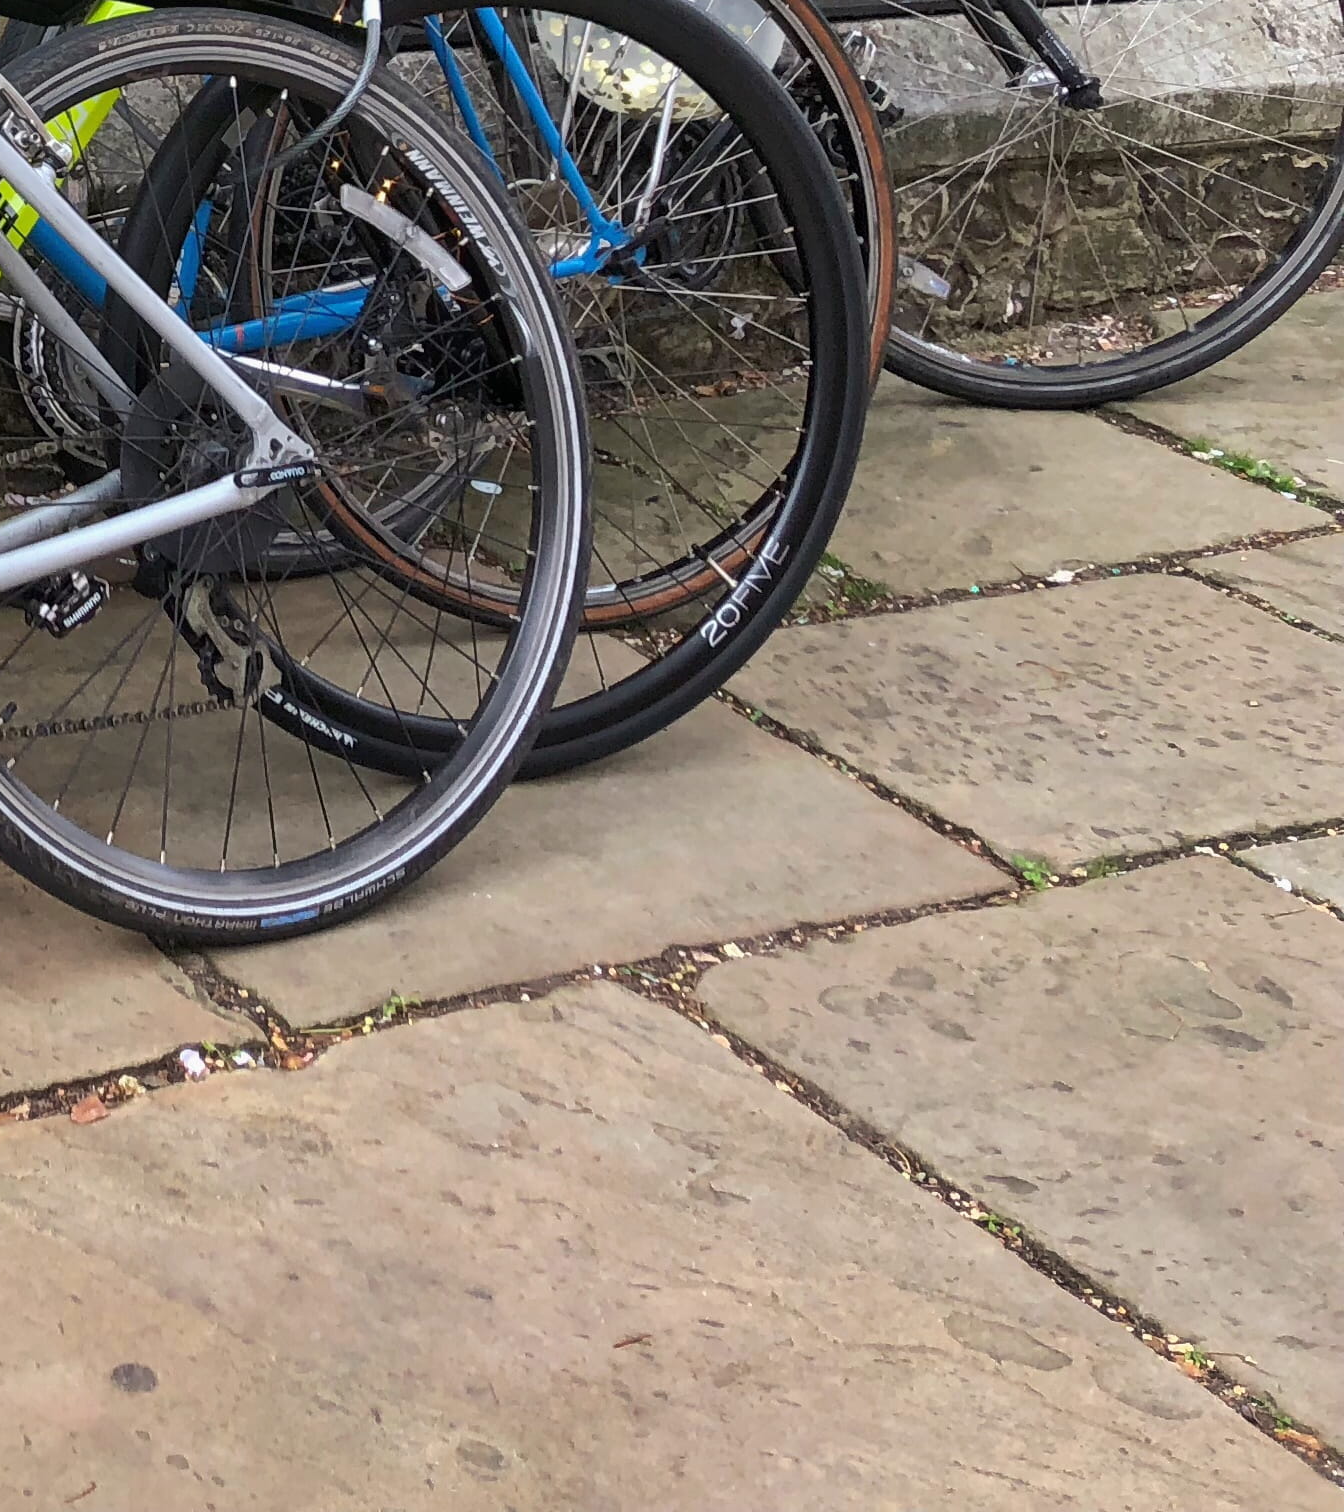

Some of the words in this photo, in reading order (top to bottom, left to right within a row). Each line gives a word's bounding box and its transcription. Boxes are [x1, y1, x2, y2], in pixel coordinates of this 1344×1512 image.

[405, 148, 487, 240] WEINMANN
[699, 536, 789, 648] 20FIVE
[324, 869, 405, 912] SCHWALBE
